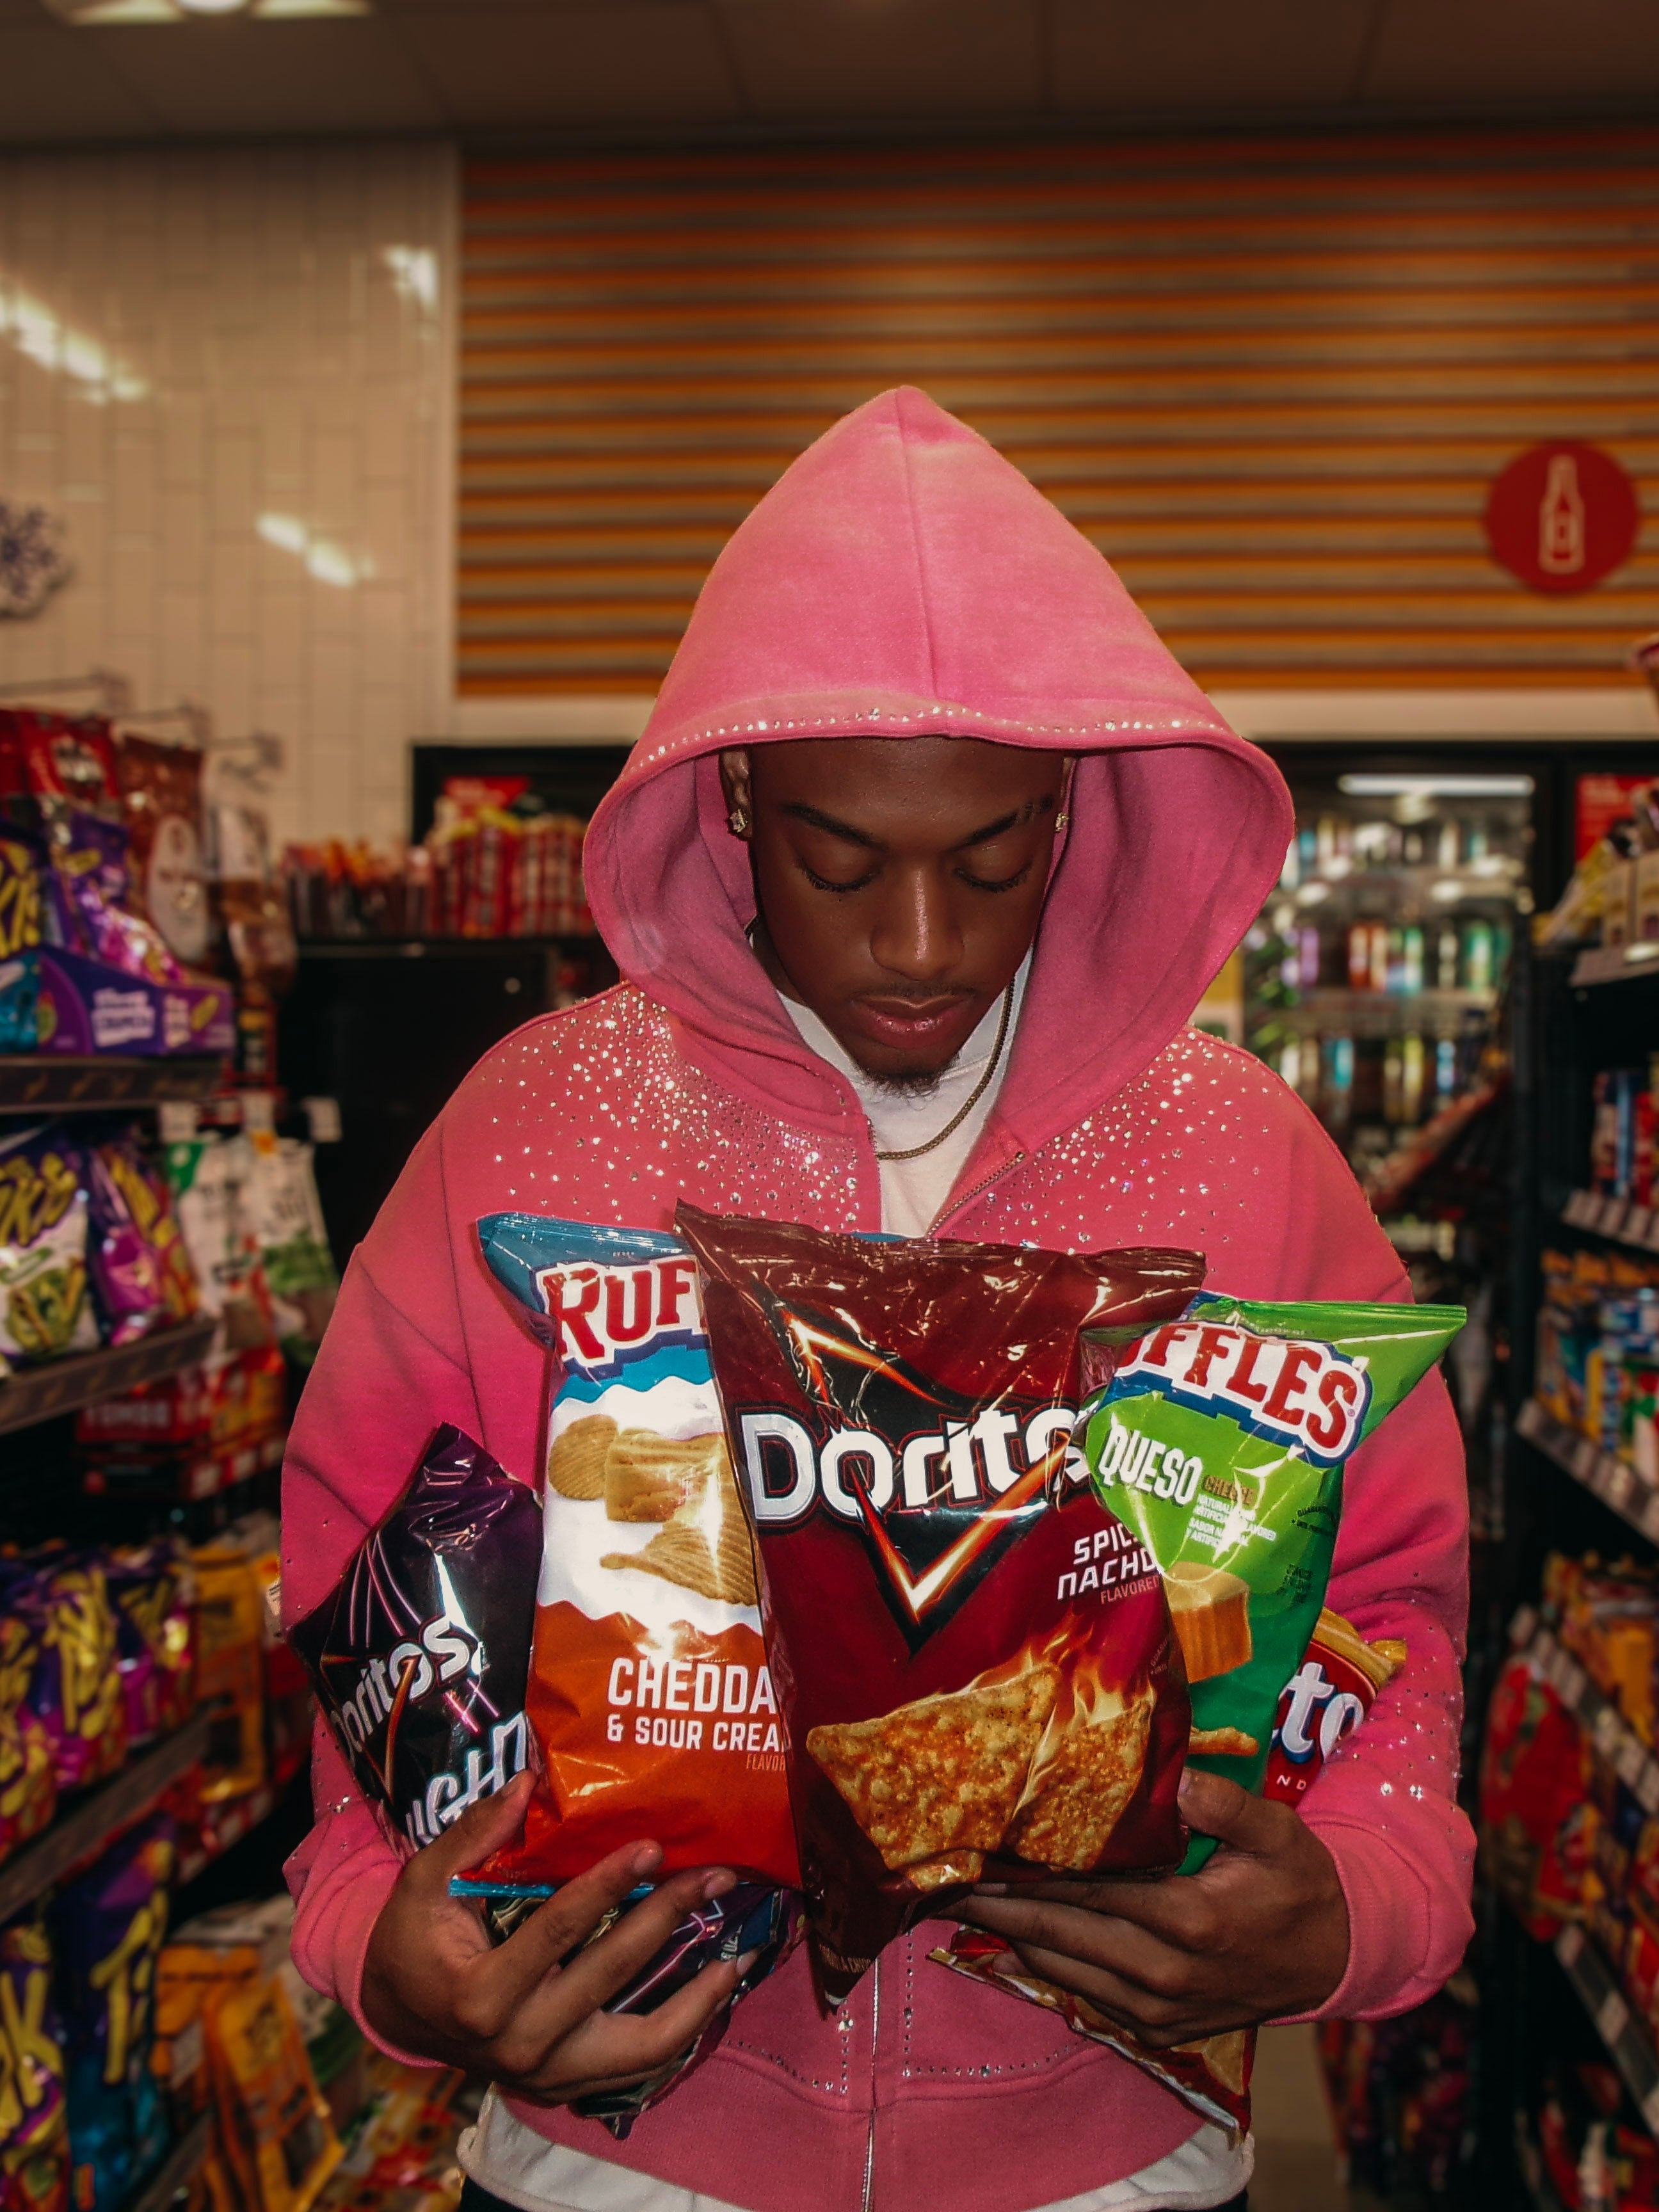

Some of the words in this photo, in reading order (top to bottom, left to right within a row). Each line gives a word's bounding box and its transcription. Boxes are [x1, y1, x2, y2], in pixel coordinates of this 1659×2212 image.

[543, 1259, 707, 1359] RUF
[1098, 1423, 1203, 1505] QUESO
[1073, 1523, 1138, 1564] SPIC
[608, 1657, 777, 1715] CHEDDA
[1272, 1662, 1365, 1763] to
[607, 1713, 624, 1742] &
[635, 1716, 703, 1750] SOUR
[712, 1722, 785, 1752] CREA
